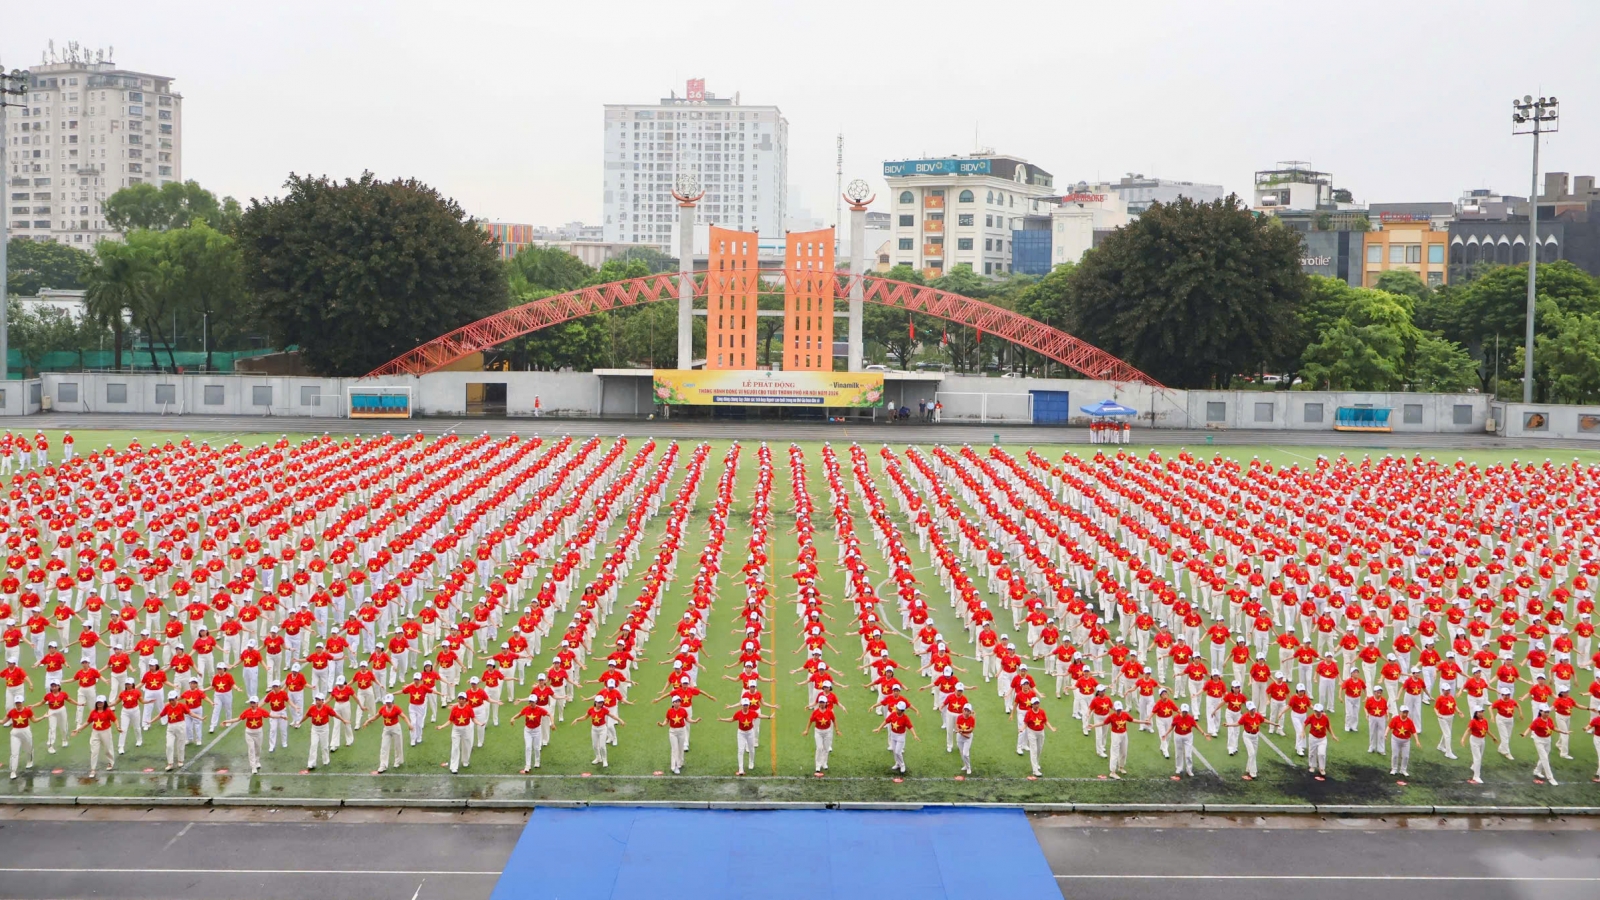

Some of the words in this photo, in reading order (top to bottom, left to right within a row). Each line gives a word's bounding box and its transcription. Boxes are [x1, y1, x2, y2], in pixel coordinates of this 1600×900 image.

[885, 165, 902, 174] BIDV
[916, 164, 935, 172] BIDV
[960, 163, 979, 171] BIDV
